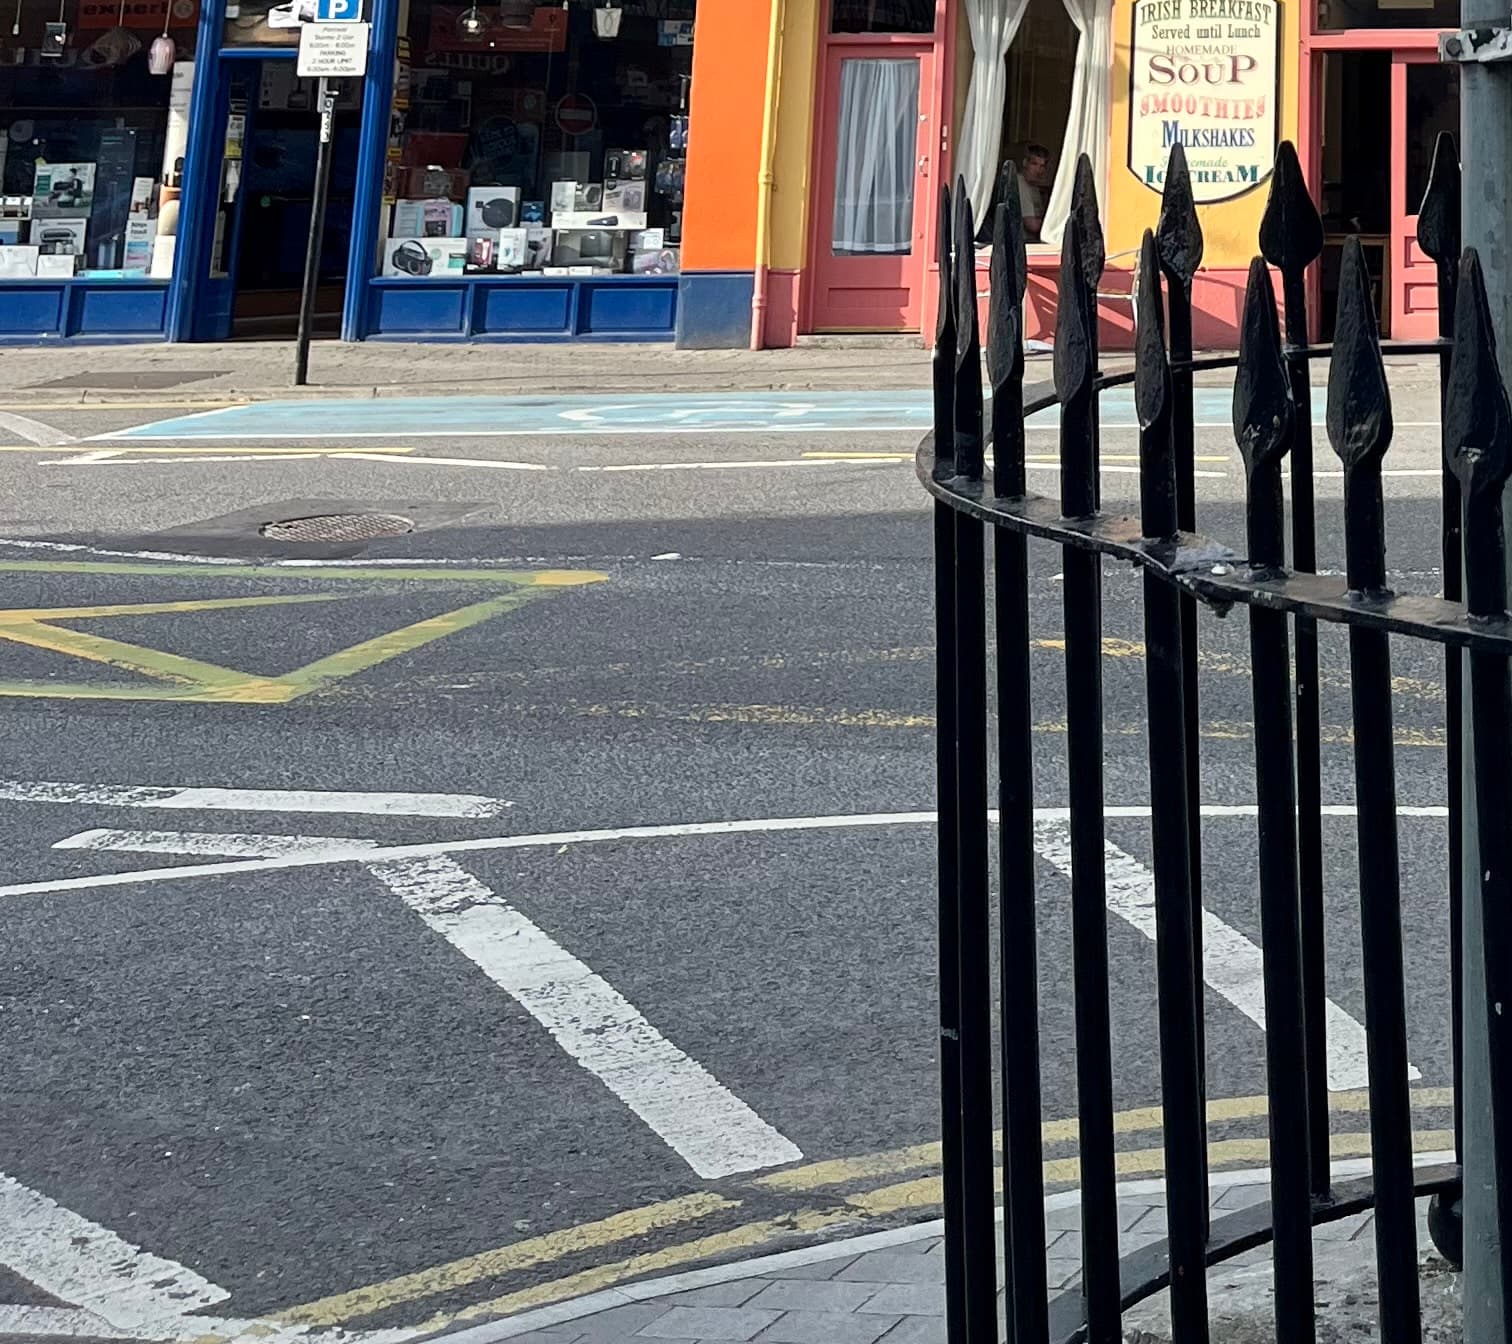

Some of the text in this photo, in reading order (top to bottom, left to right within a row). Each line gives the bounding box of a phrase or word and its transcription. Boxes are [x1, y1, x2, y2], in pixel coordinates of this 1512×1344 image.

[1140, 0, 1182, 26] IRISH
[1152, 24, 1261, 39] Served until Lunch
[1166, 45, 1237, 56] HOMEMADE
[1148, 54, 1257, 85] SOUP
[1139, 92, 1266, 120] SMOOTHIES
[1161, 119, 1255, 149] MILKSHAKES
